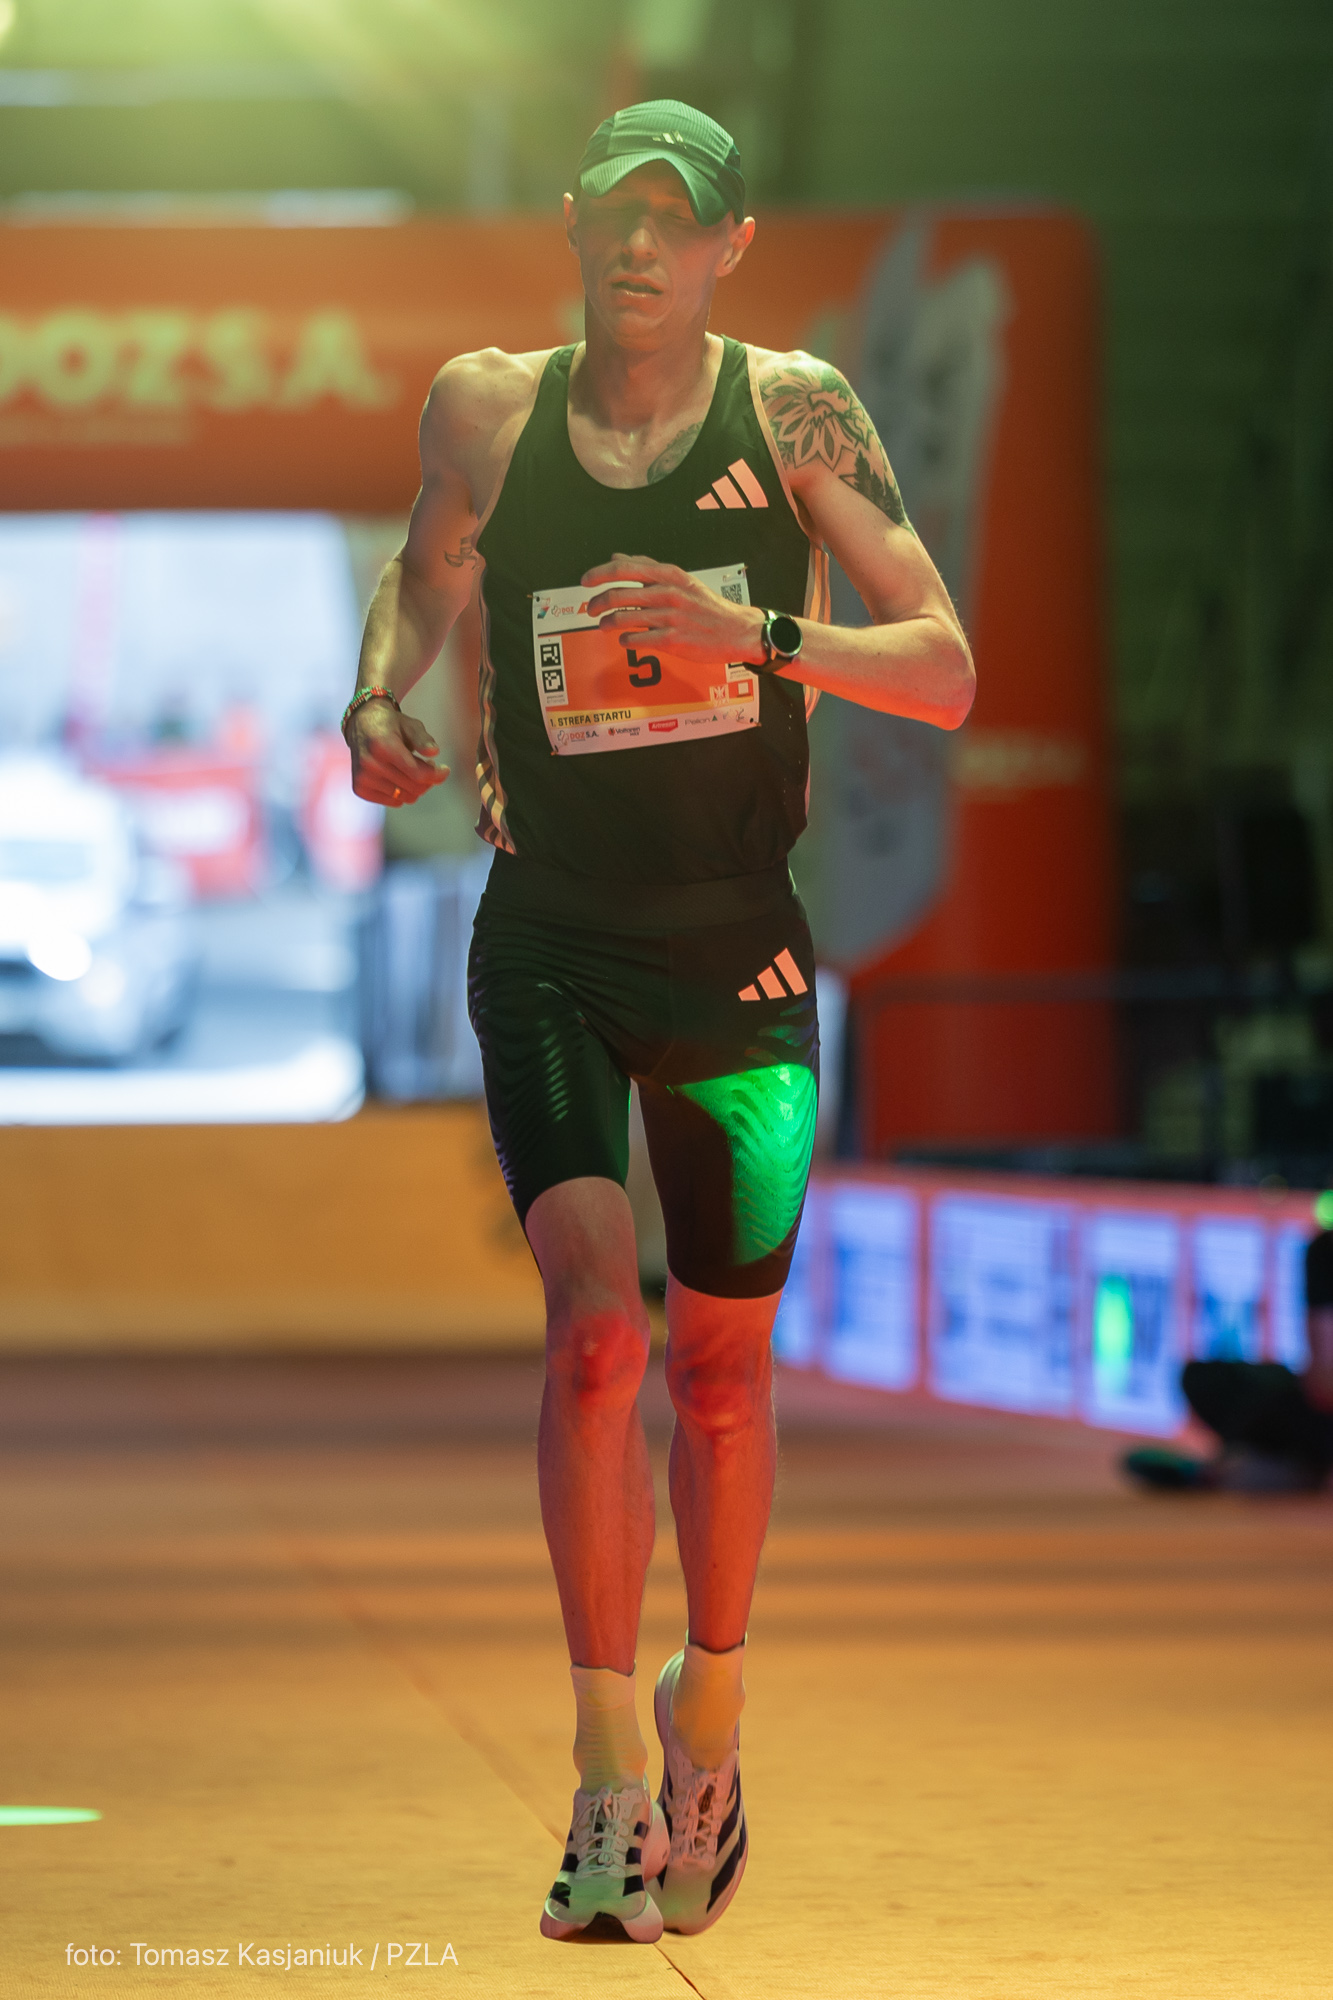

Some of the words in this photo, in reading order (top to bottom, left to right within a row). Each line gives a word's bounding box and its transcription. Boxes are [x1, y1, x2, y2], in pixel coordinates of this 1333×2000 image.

[626, 648, 662, 688] 5
[558, 715, 592, 727] STREFA
[593, 710, 632, 722] STARTU
[569, 731, 585, 740] DOZ
